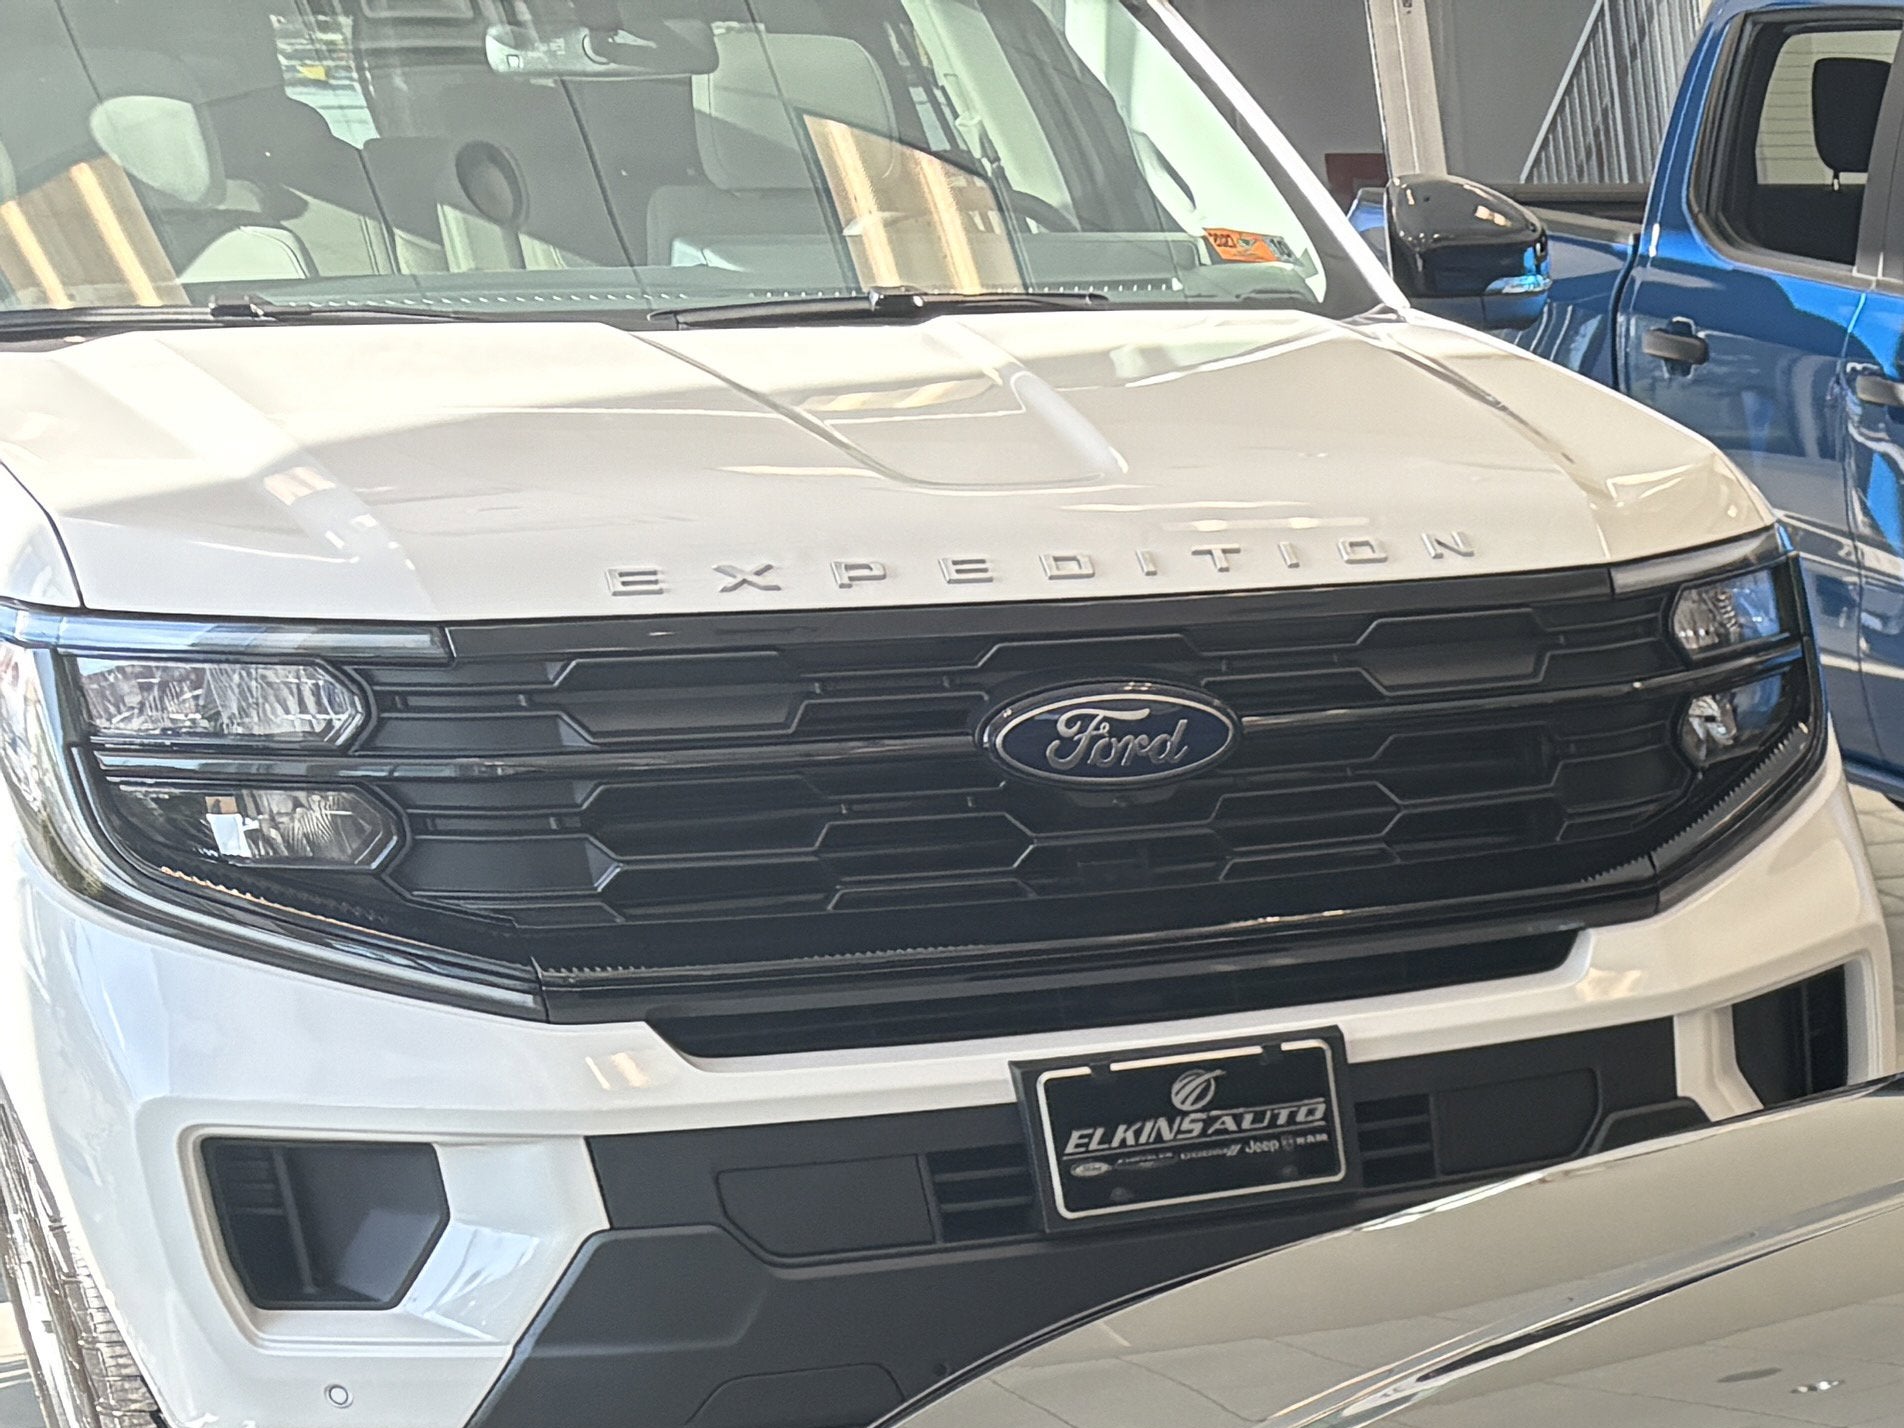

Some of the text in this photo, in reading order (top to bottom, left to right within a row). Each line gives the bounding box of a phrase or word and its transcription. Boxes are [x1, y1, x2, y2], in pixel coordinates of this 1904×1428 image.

[605, 530, 1477, 597] EXPEDITION
[1045, 707, 1189, 770] Ford
[1064, 1102, 1327, 1154] ELKINS AUTO
